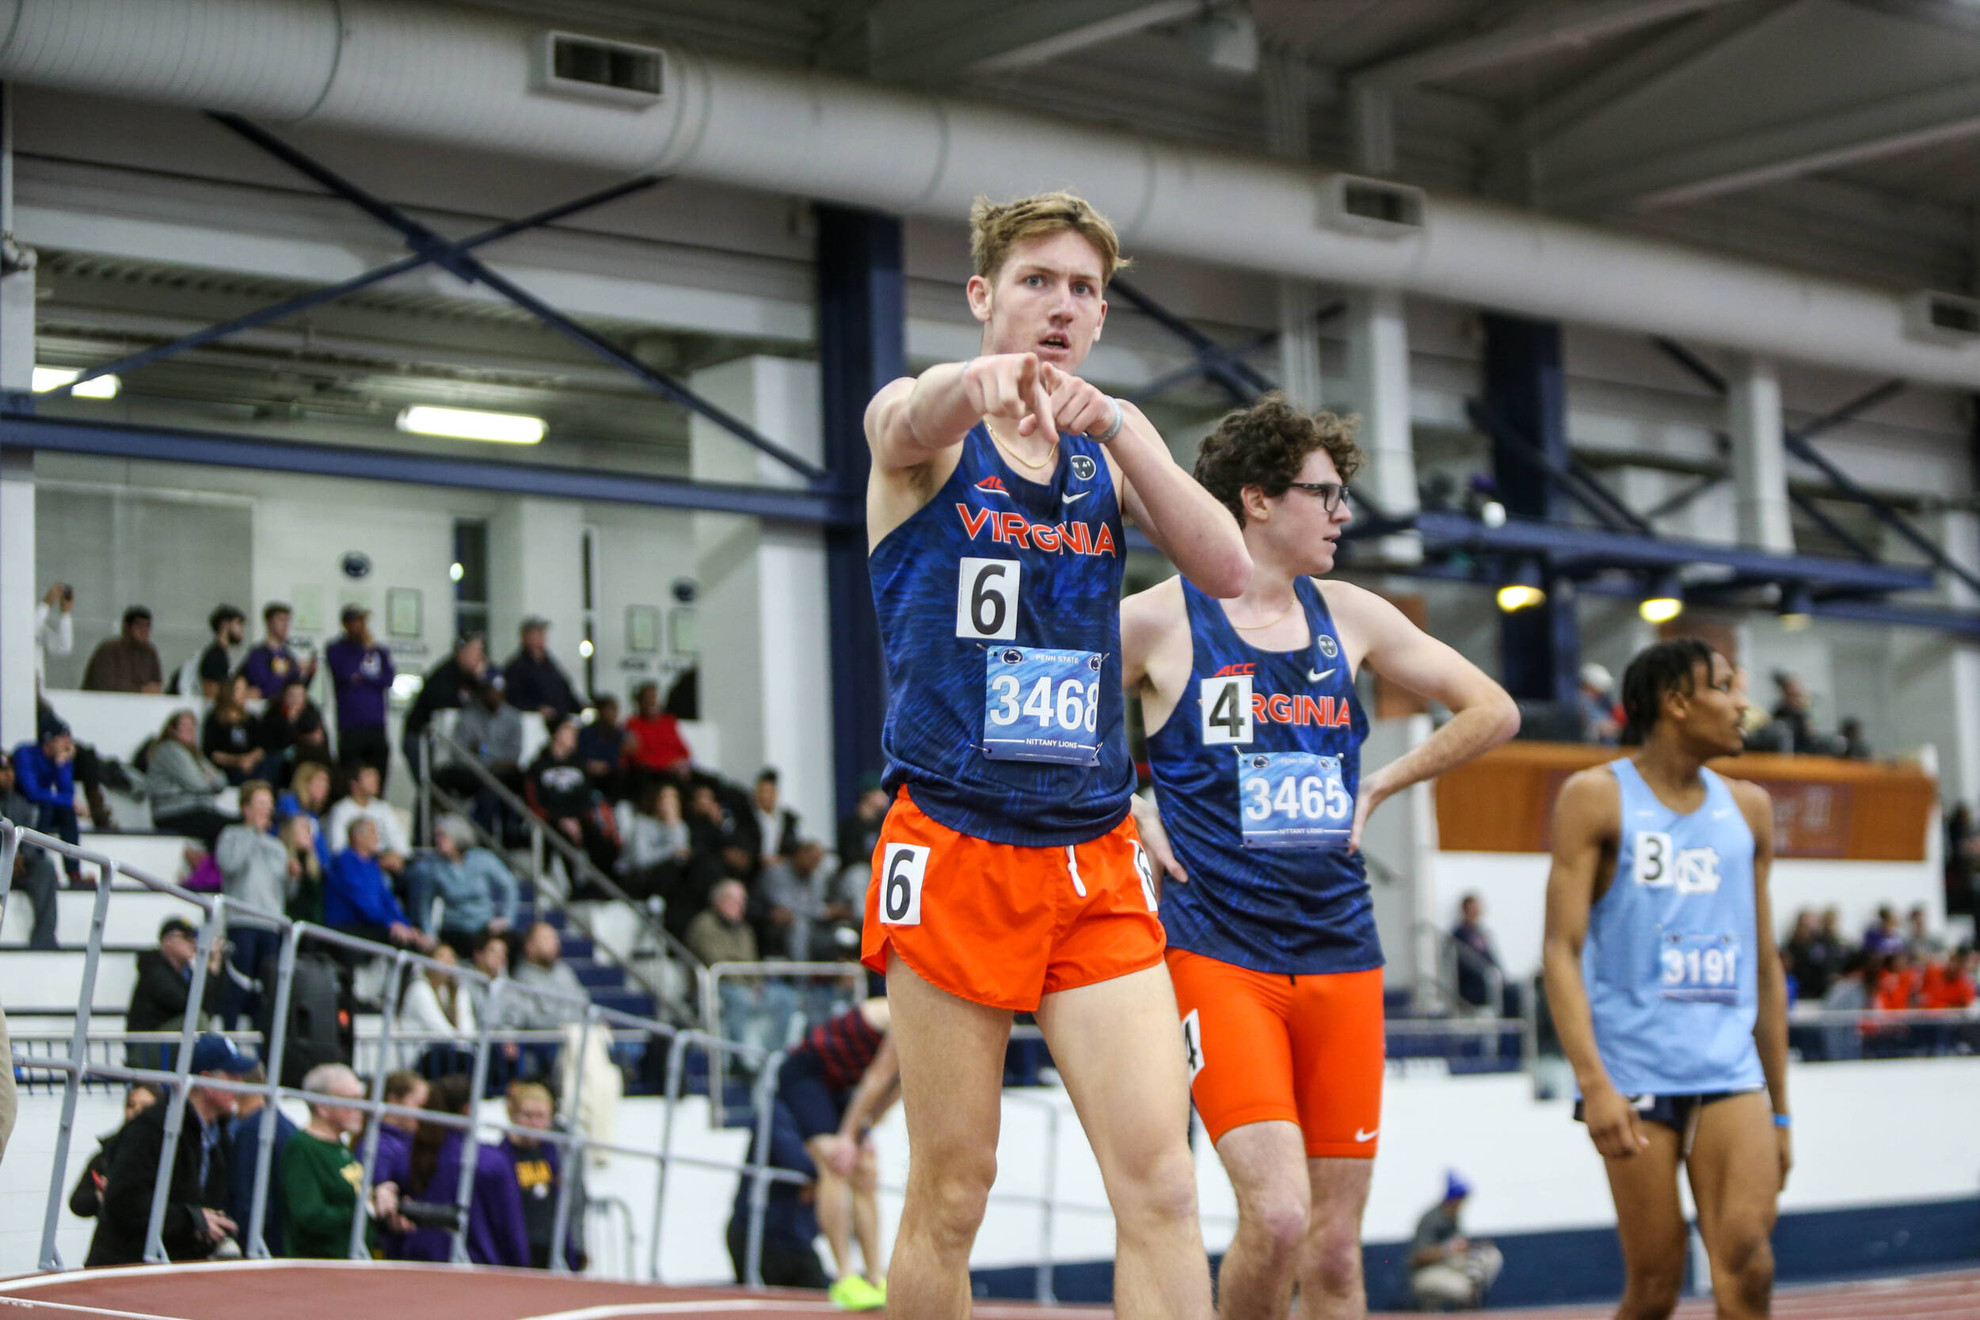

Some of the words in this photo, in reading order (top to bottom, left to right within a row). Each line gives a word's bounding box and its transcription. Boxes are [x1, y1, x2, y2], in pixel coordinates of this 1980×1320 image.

[976, 475, 1011, 495] AC
[970, 564, 1006, 635] 6
[1035, 654, 1056, 662] PENN
[1058, 656, 1079, 664] STATE
[1213, 662, 1257, 677] ACC
[989, 674, 1100, 733] 3468
[1198, 692, 1351, 729] RGINIA
[1209, 681, 1245, 738] 4
[1026, 738, 1057, 746] NITTANY
[1058, 741, 1078, 749] LIONS
[1245, 776, 1348, 820] 3465
[1644, 836, 1663, 881] 3
[886, 849, 915, 921] 6
[1662, 948, 1736, 986] 3191
